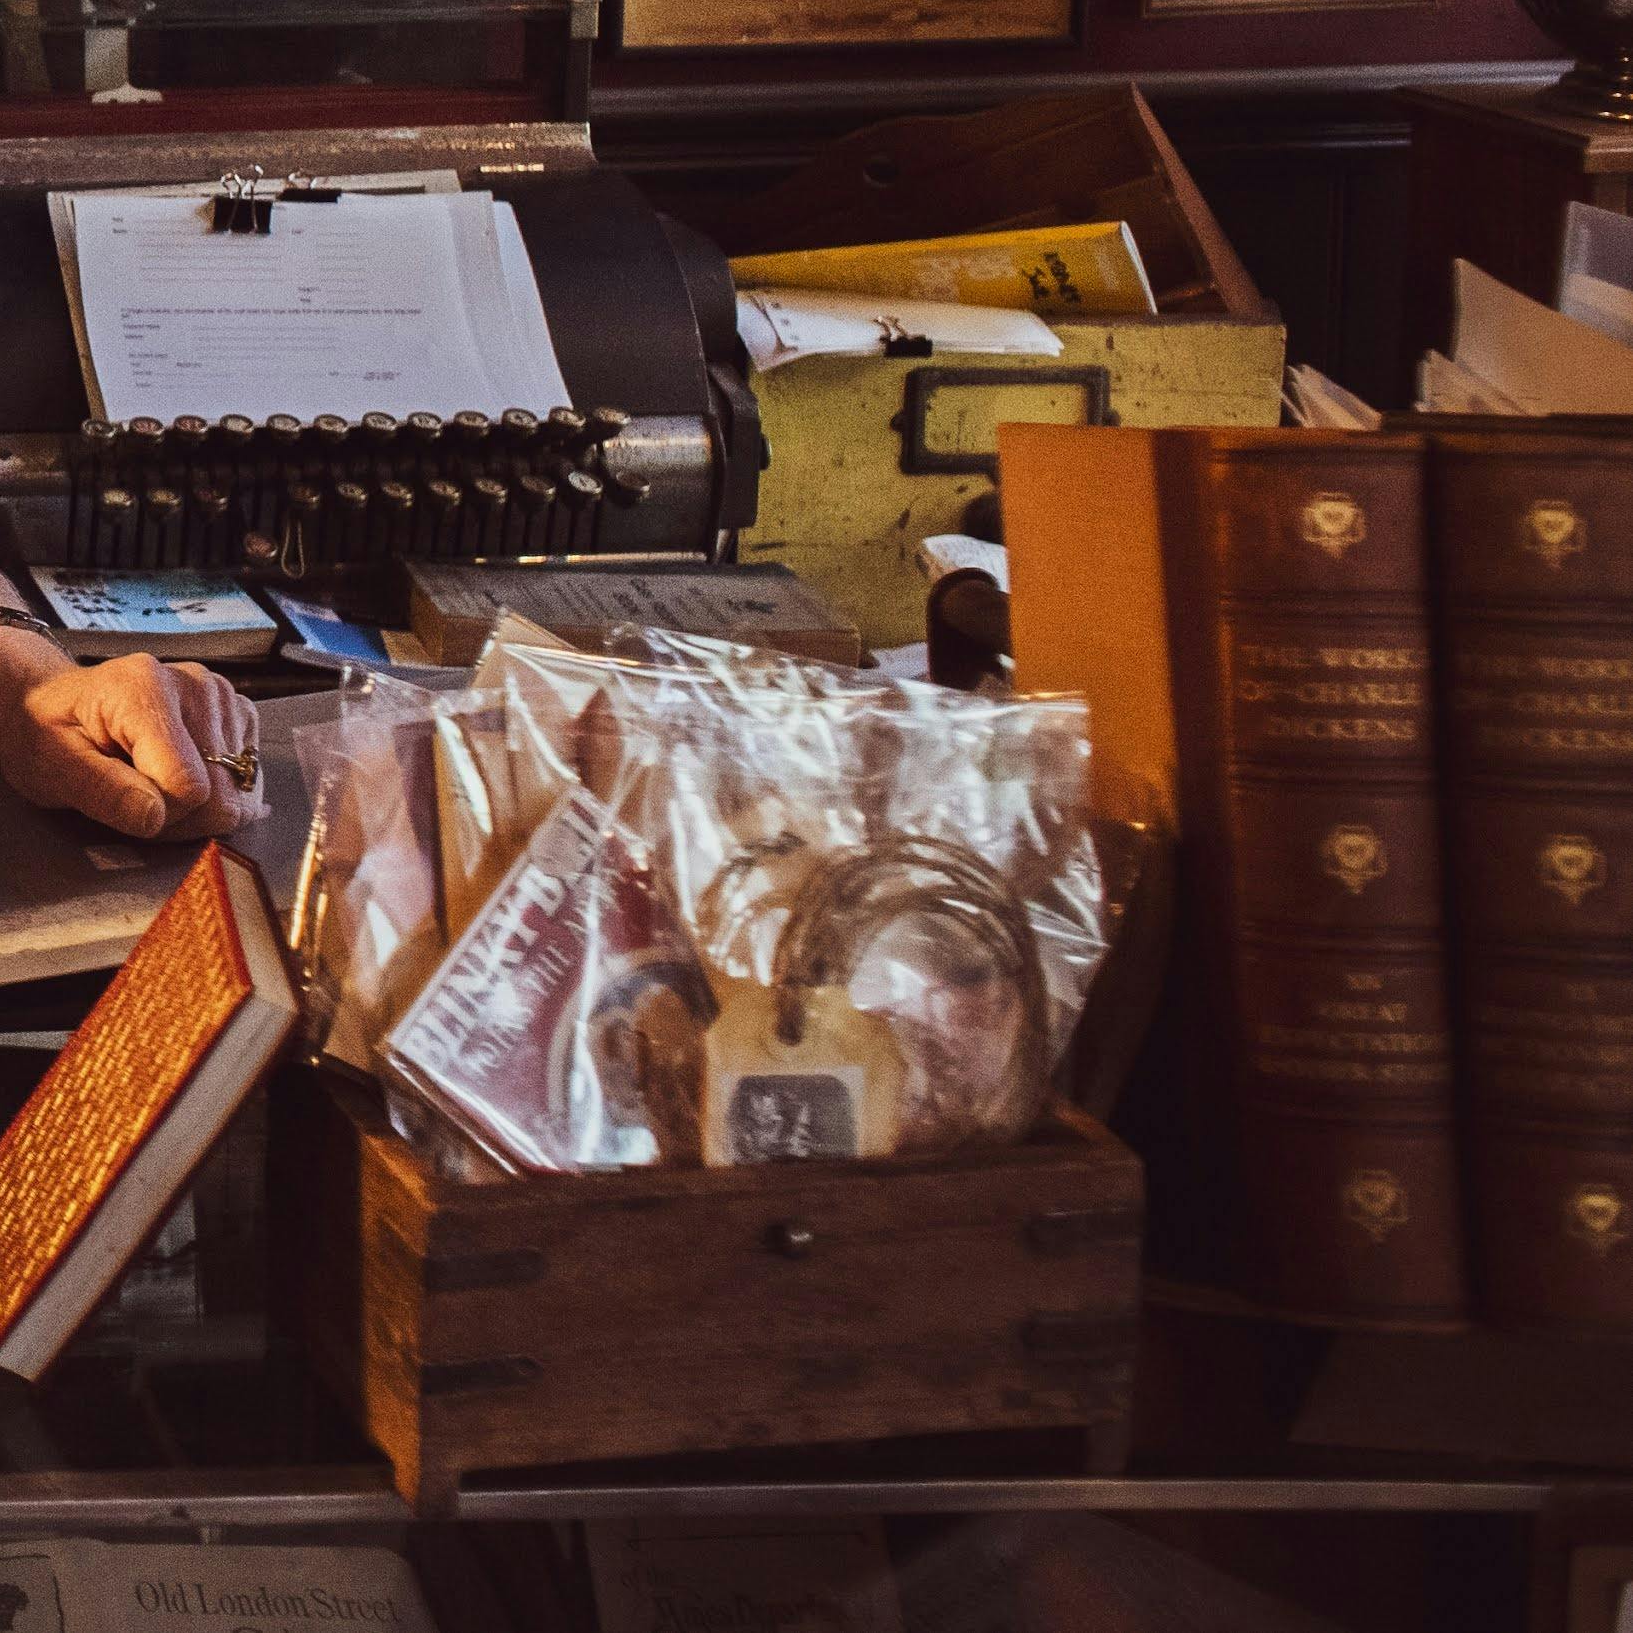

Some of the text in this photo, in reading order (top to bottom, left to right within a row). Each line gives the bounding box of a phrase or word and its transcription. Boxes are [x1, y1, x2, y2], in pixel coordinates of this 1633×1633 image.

[135, 1579, 403, 1624] Old London Street
